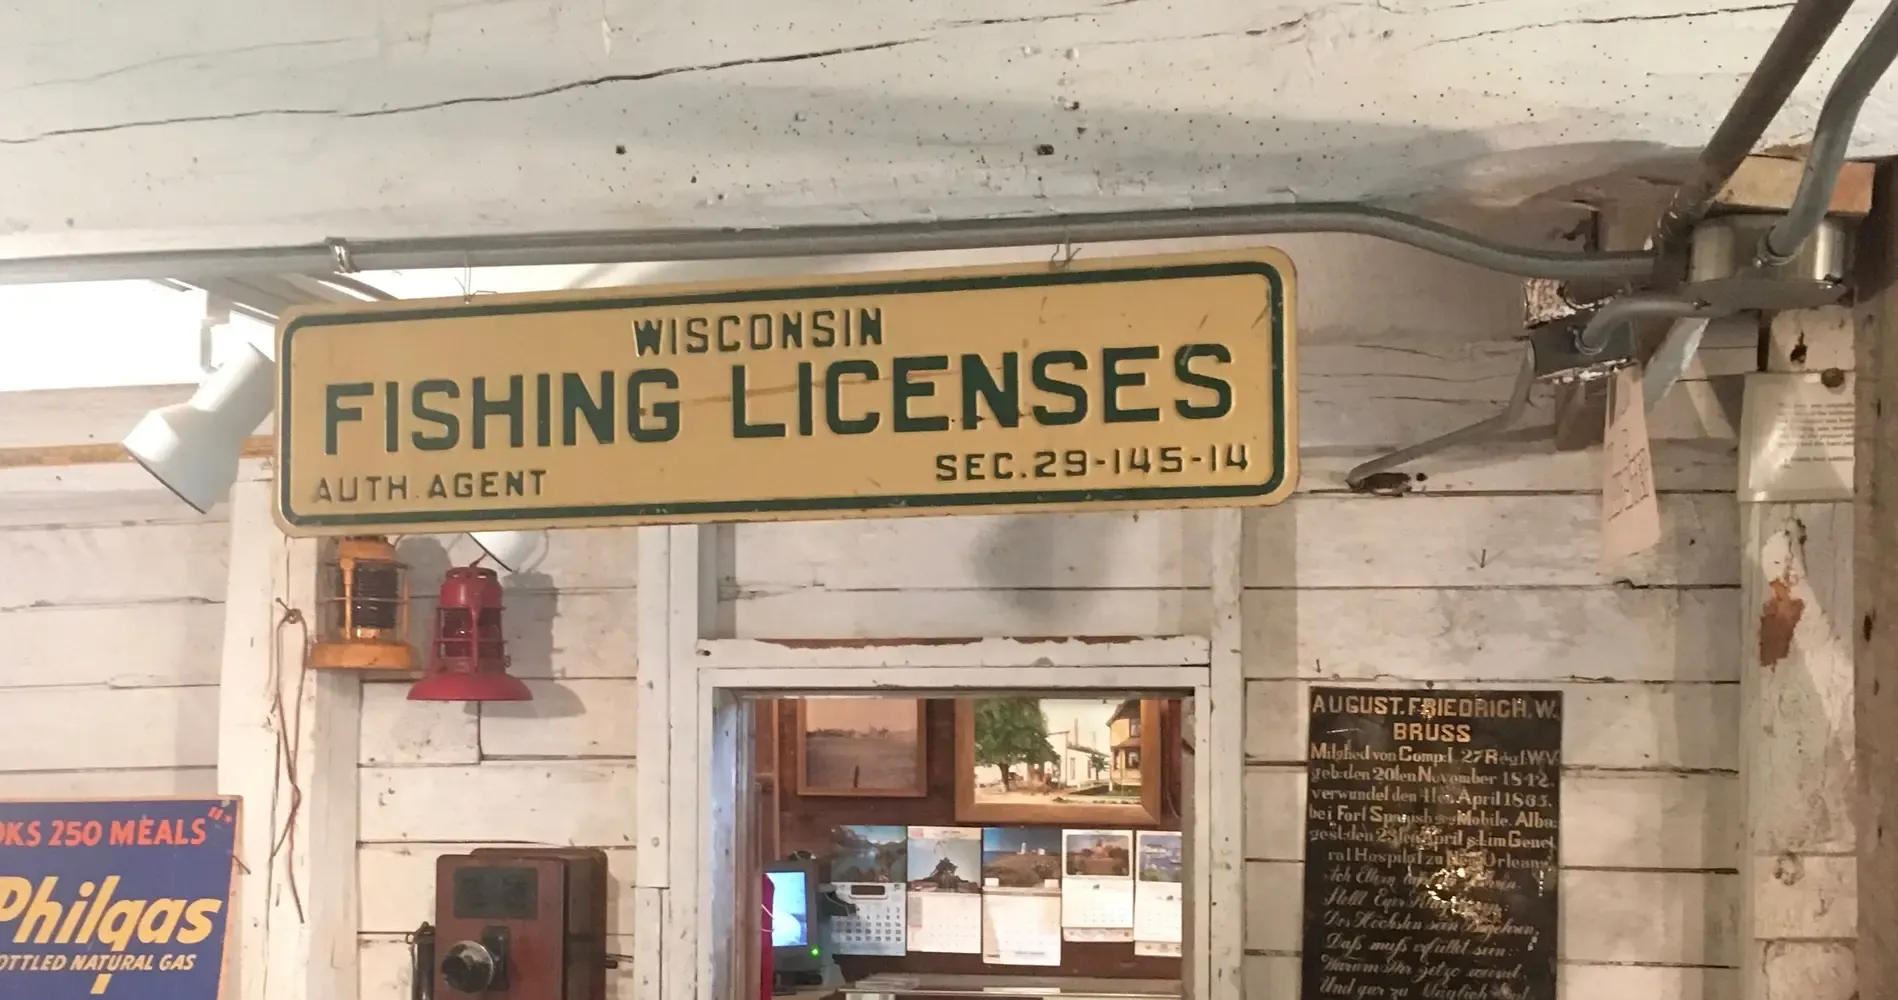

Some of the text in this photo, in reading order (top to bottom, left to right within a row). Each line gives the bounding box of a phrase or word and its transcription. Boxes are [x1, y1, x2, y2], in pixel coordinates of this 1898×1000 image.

[635, 307, 882, 357] WISCONSIN
[325, 343, 1234, 455] FISHING LICENSES
[427, 470, 548, 499] AGENT
[1393, 722, 1471, 743] BRUSS
[1418, 764, 1497, 785] November
[1391, 785, 1417, 802] den
[1457, 786, 1501, 810] April
[1309, 803, 1333, 820] bei
[48, 818, 102, 847] 250
[70, 953, 153, 971] NATURAL
[158, 953, 196, 971] GAS
